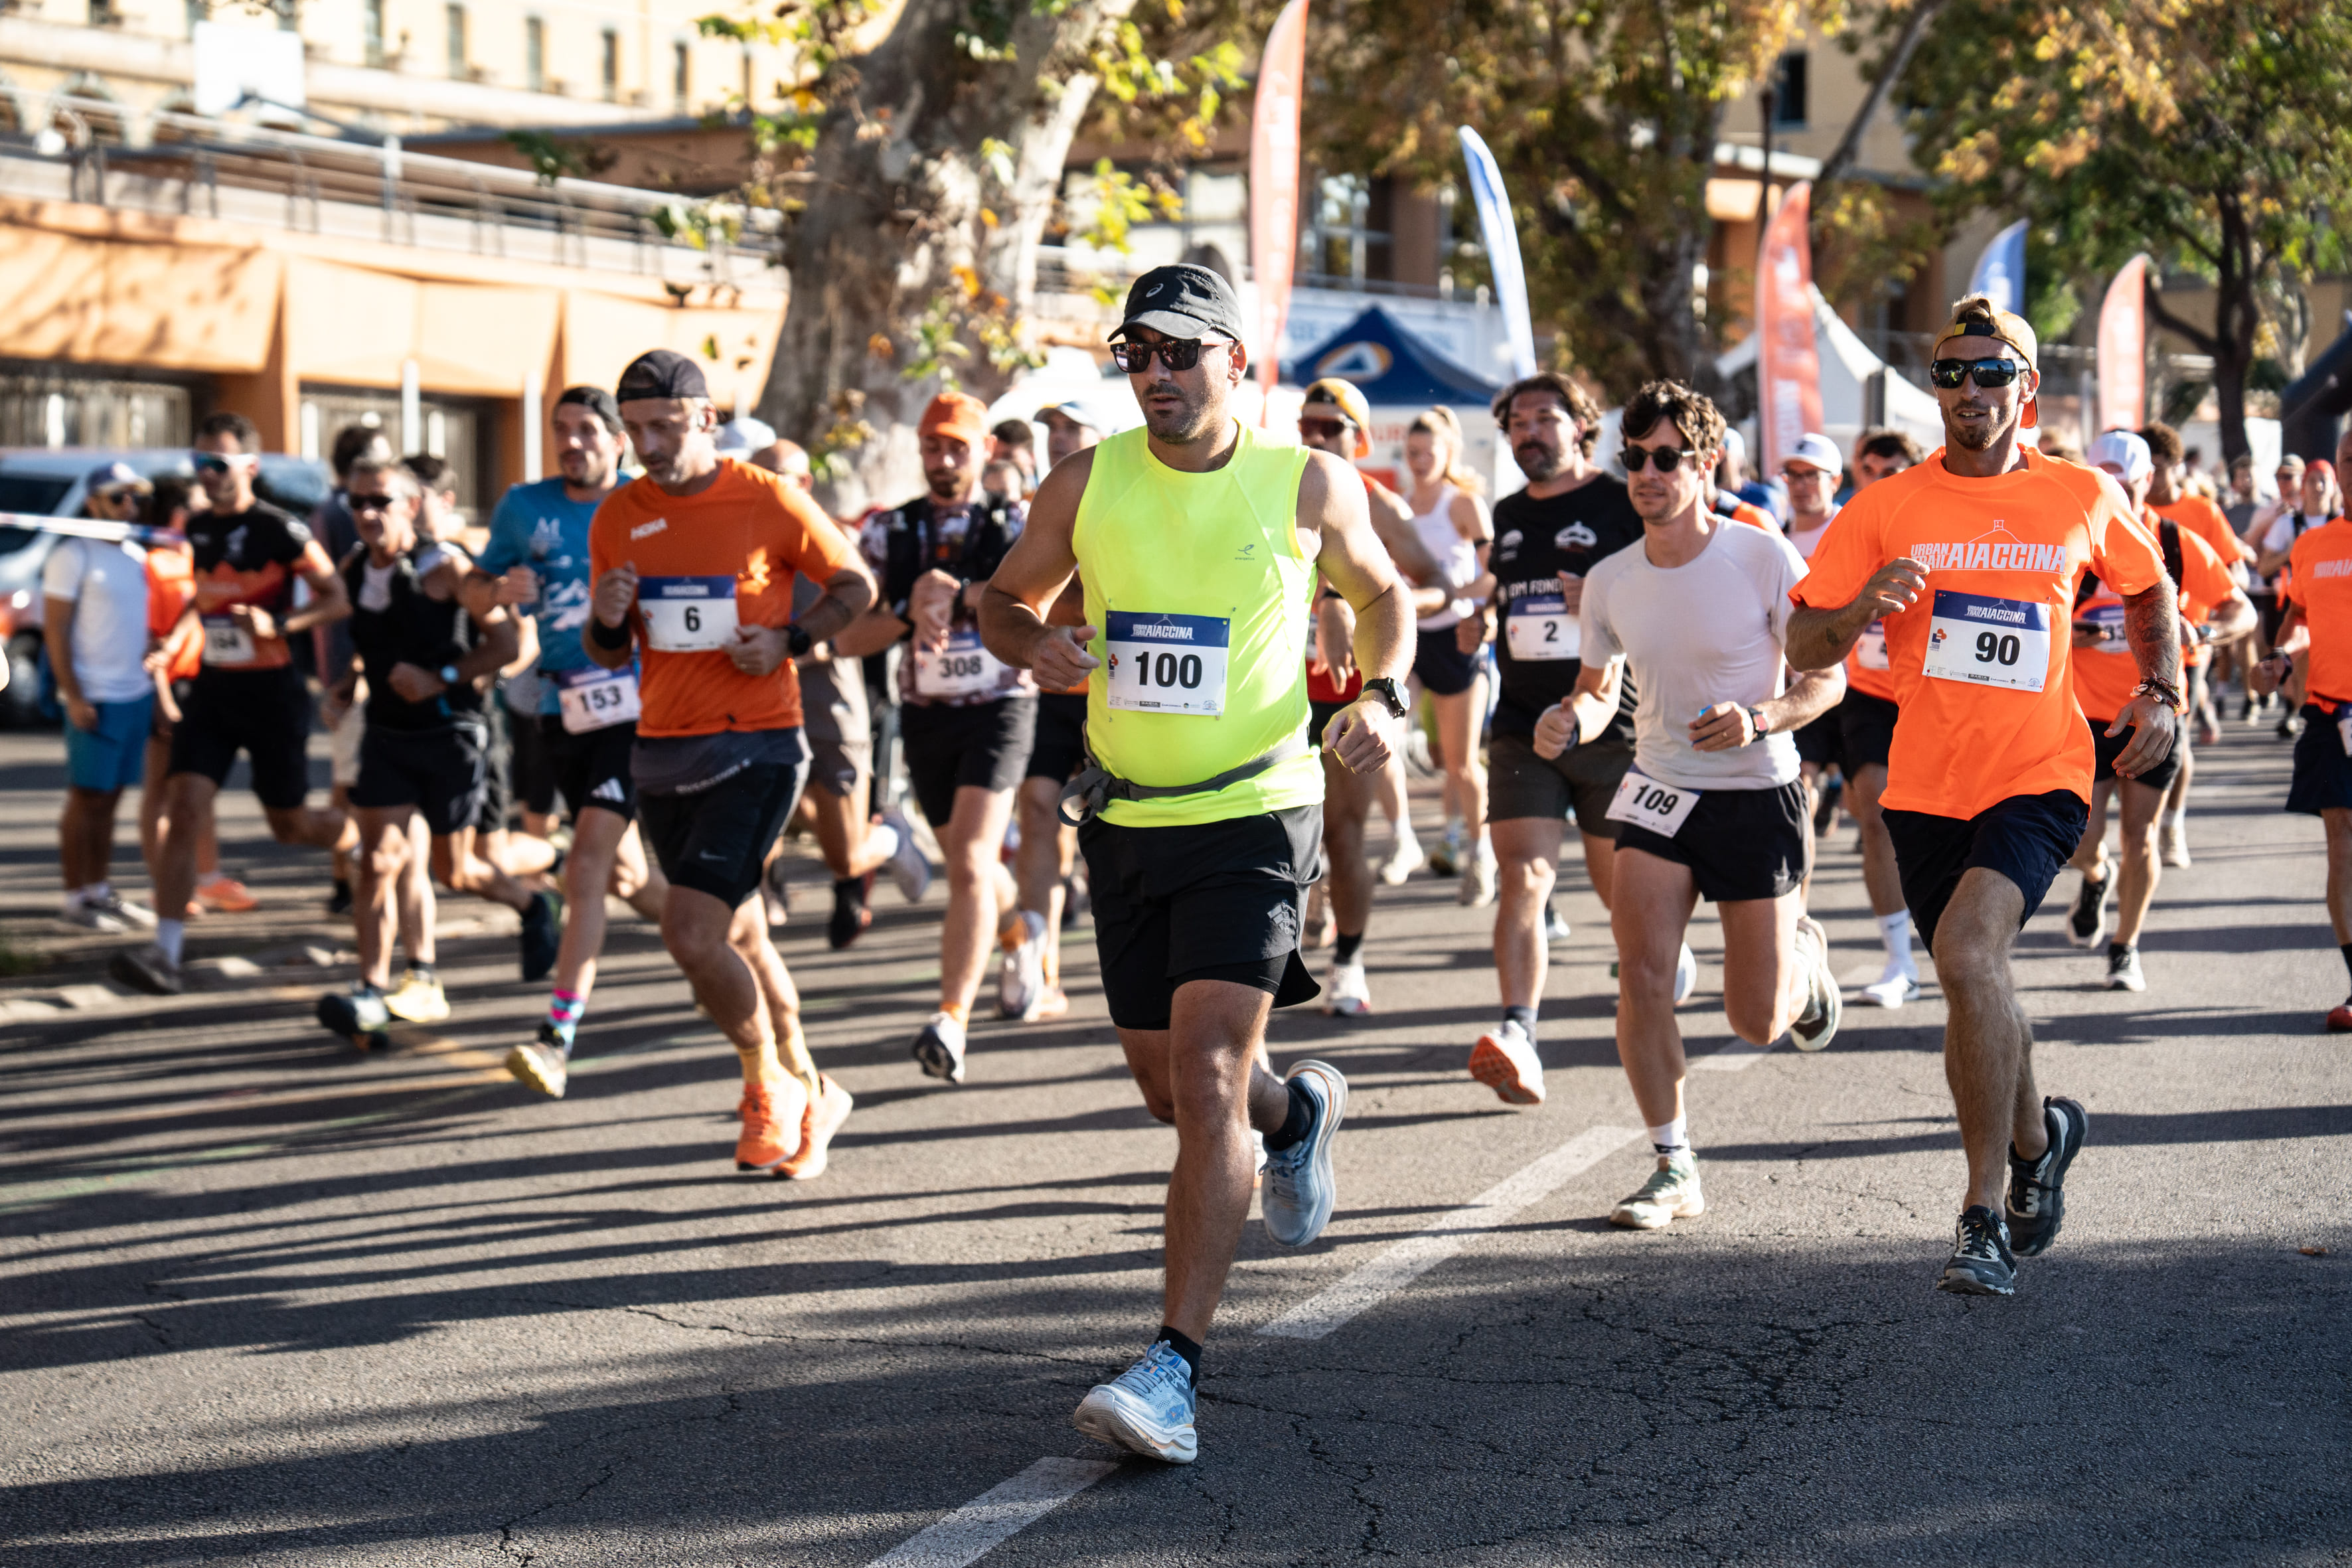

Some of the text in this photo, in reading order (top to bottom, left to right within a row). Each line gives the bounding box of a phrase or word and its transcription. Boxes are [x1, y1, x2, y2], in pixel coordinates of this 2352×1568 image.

[1911, 542, 1950, 556] URBAN
[1944, 543, 2067, 572] AIACCINA
[684, 605, 700, 632] 6
[1980, 607, 2026, 623] AIACCINA
[1145, 625, 1193, 639] AIACCINA
[1543, 620, 1558, 642] 2
[1975, 631, 2020, 666] 90
[939, 655, 982, 678] 308
[1135, 651, 1202, 688] 100
[578, 686, 623, 712] 153
[1632, 784, 1679, 815] 109
